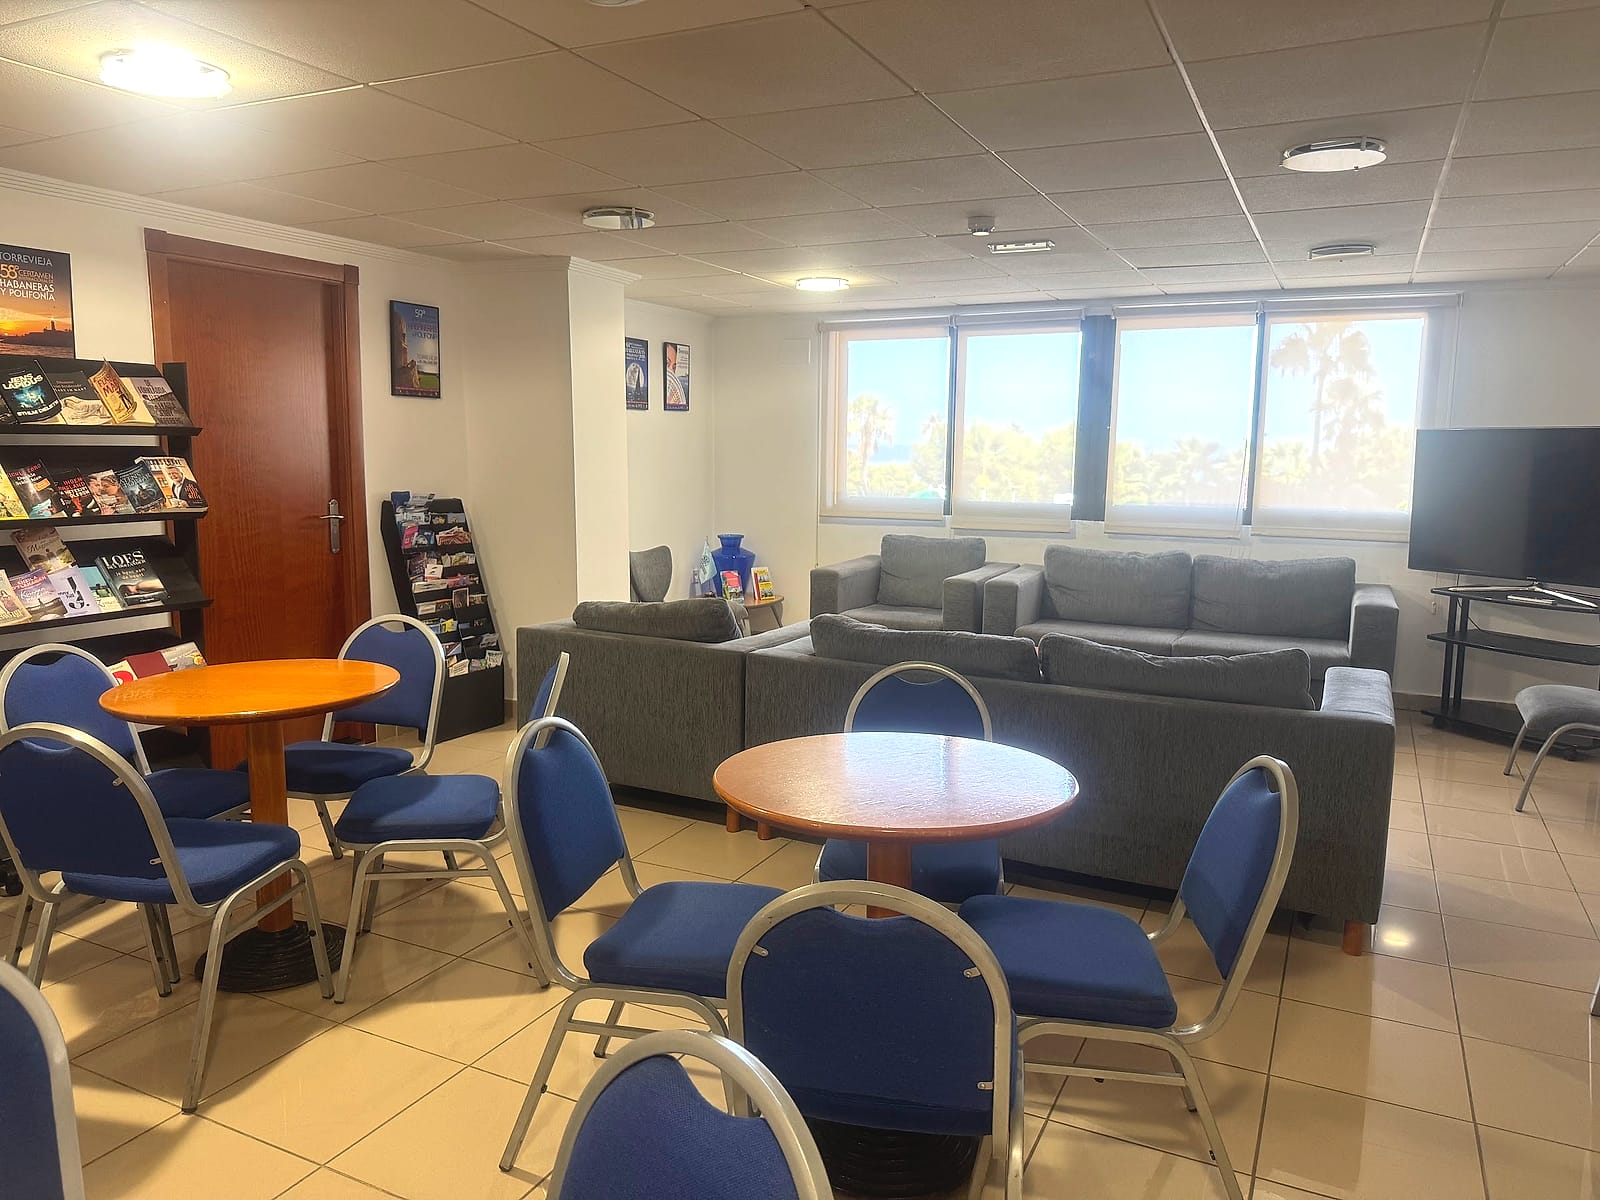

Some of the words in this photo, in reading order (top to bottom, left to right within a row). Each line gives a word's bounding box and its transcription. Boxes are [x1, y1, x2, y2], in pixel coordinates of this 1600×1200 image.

[0, 252, 53, 267] TORREVIEJA
[18, 269, 54, 280] CERTAMEN
[0, 279, 55, 293] HABANERAS
[0, 287, 7, 296] Y
[2, 375, 44, 390] LAPIDUS
[8, 373, 33, 384] JENS
[101, 550, 144, 568] LOES
